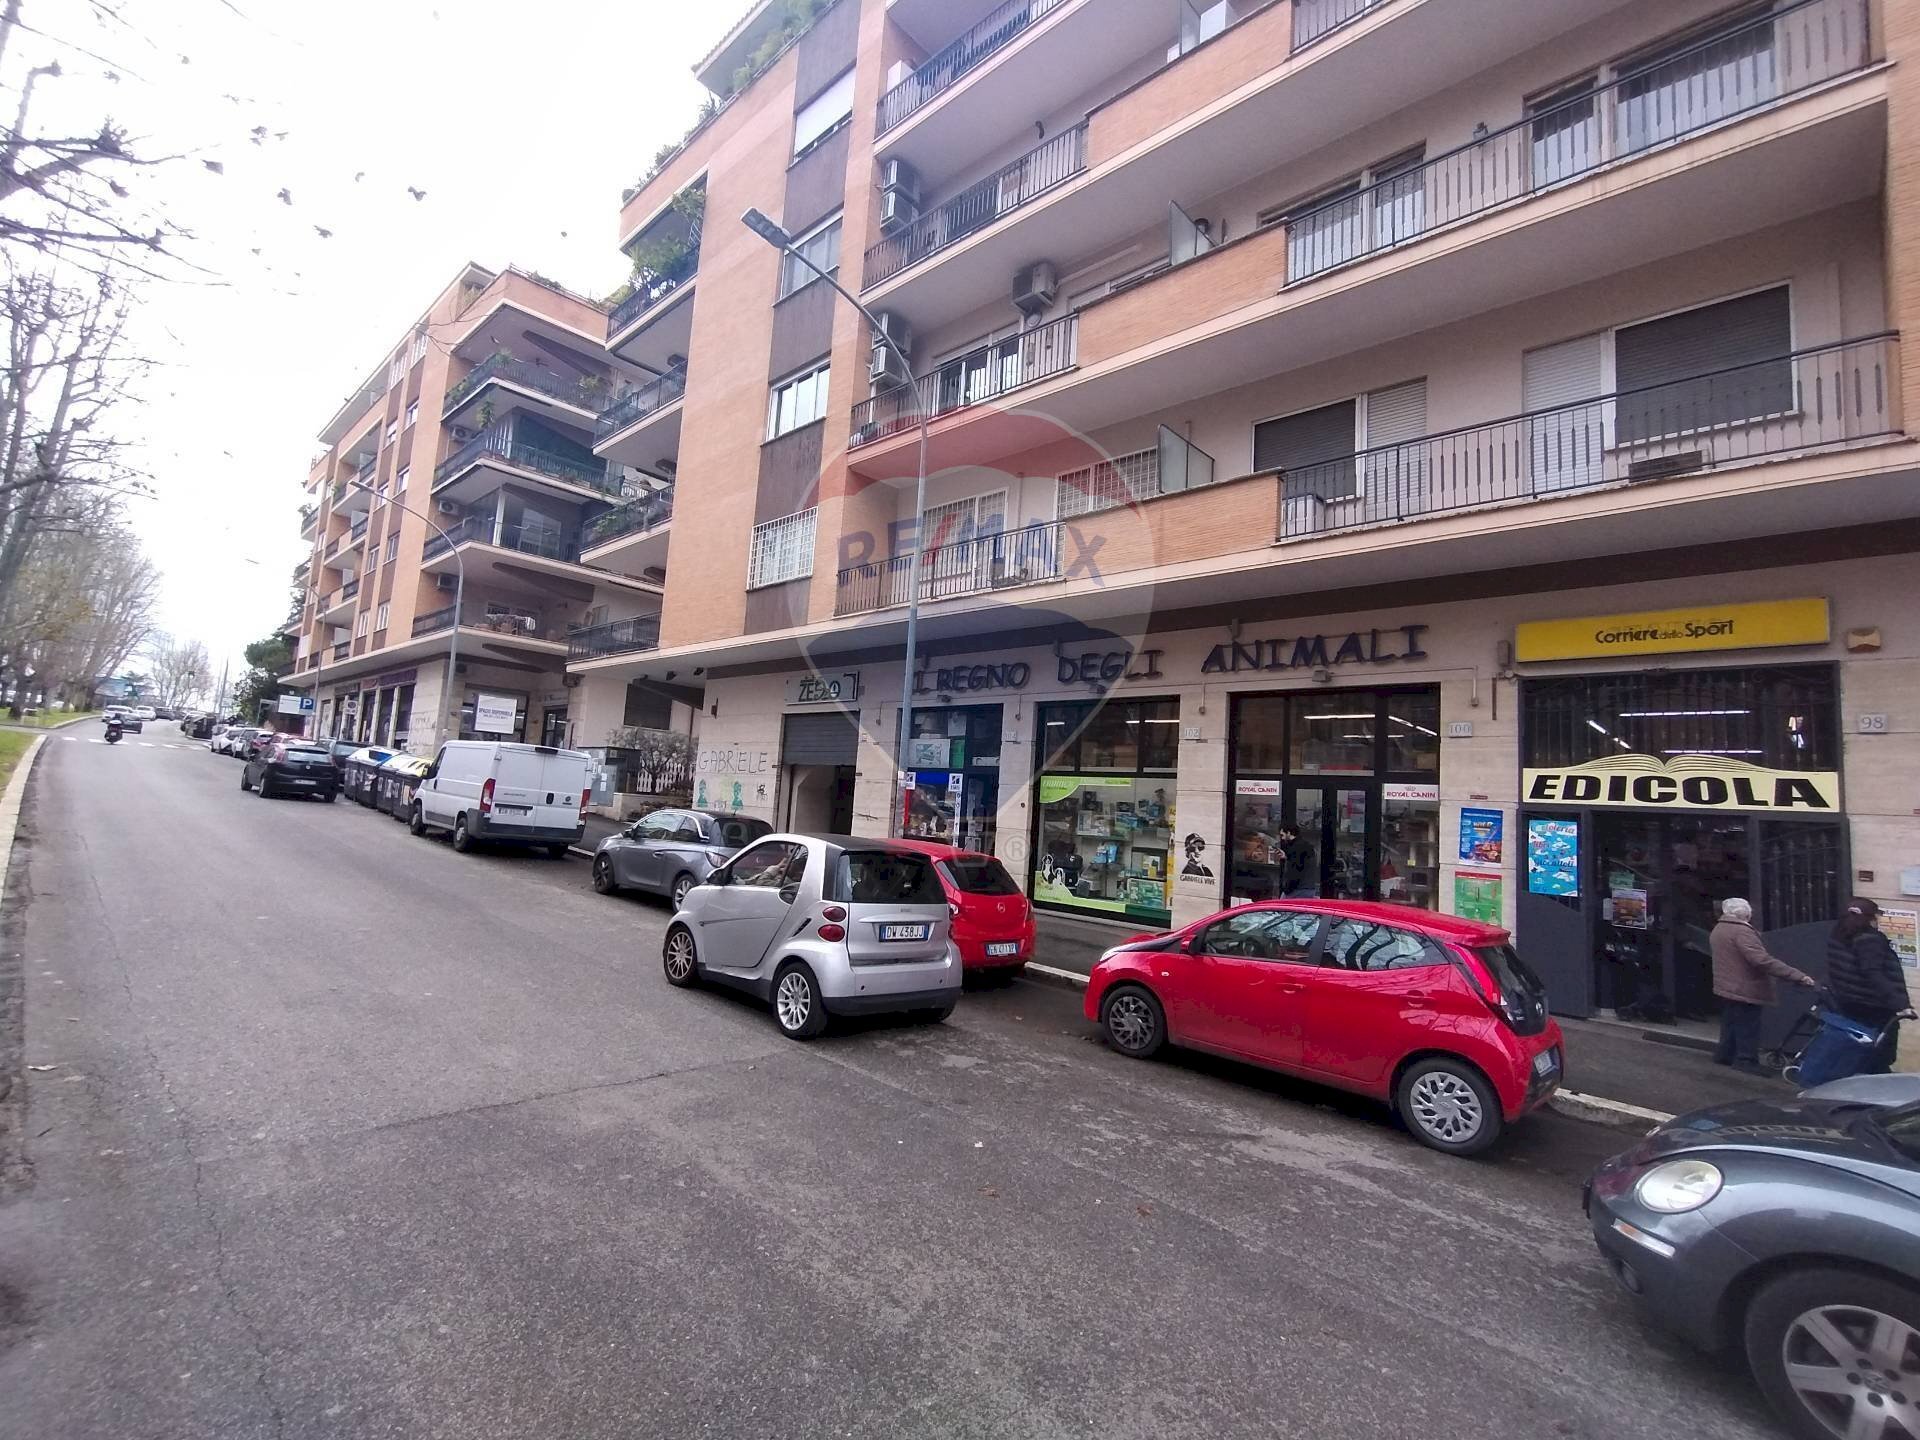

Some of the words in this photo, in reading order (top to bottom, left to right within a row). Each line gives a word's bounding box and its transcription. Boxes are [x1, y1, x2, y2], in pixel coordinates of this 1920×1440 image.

[1595, 627, 1659, 643] Corriere
[1684, 619, 1734, 639] Sport
[937, 661, 1031, 692] REGNO
[1057, 649, 1165, 684] DEGLI
[1201, 624, 1430, 673] ANIMALI
[302, 698, 312, 709] P
[1449, 723, 1472, 734] 100
[1861, 716, 1884, 730] 98
[1184, 728, 1200, 738] 102
[698, 750, 768, 774] GABRIELE
[1528, 773, 1831, 809] EDICOLA
[1203, 878, 1216, 886] VIVE
[886, 926, 898, 939] DW
[899, 926, 925, 939] 438JJ
